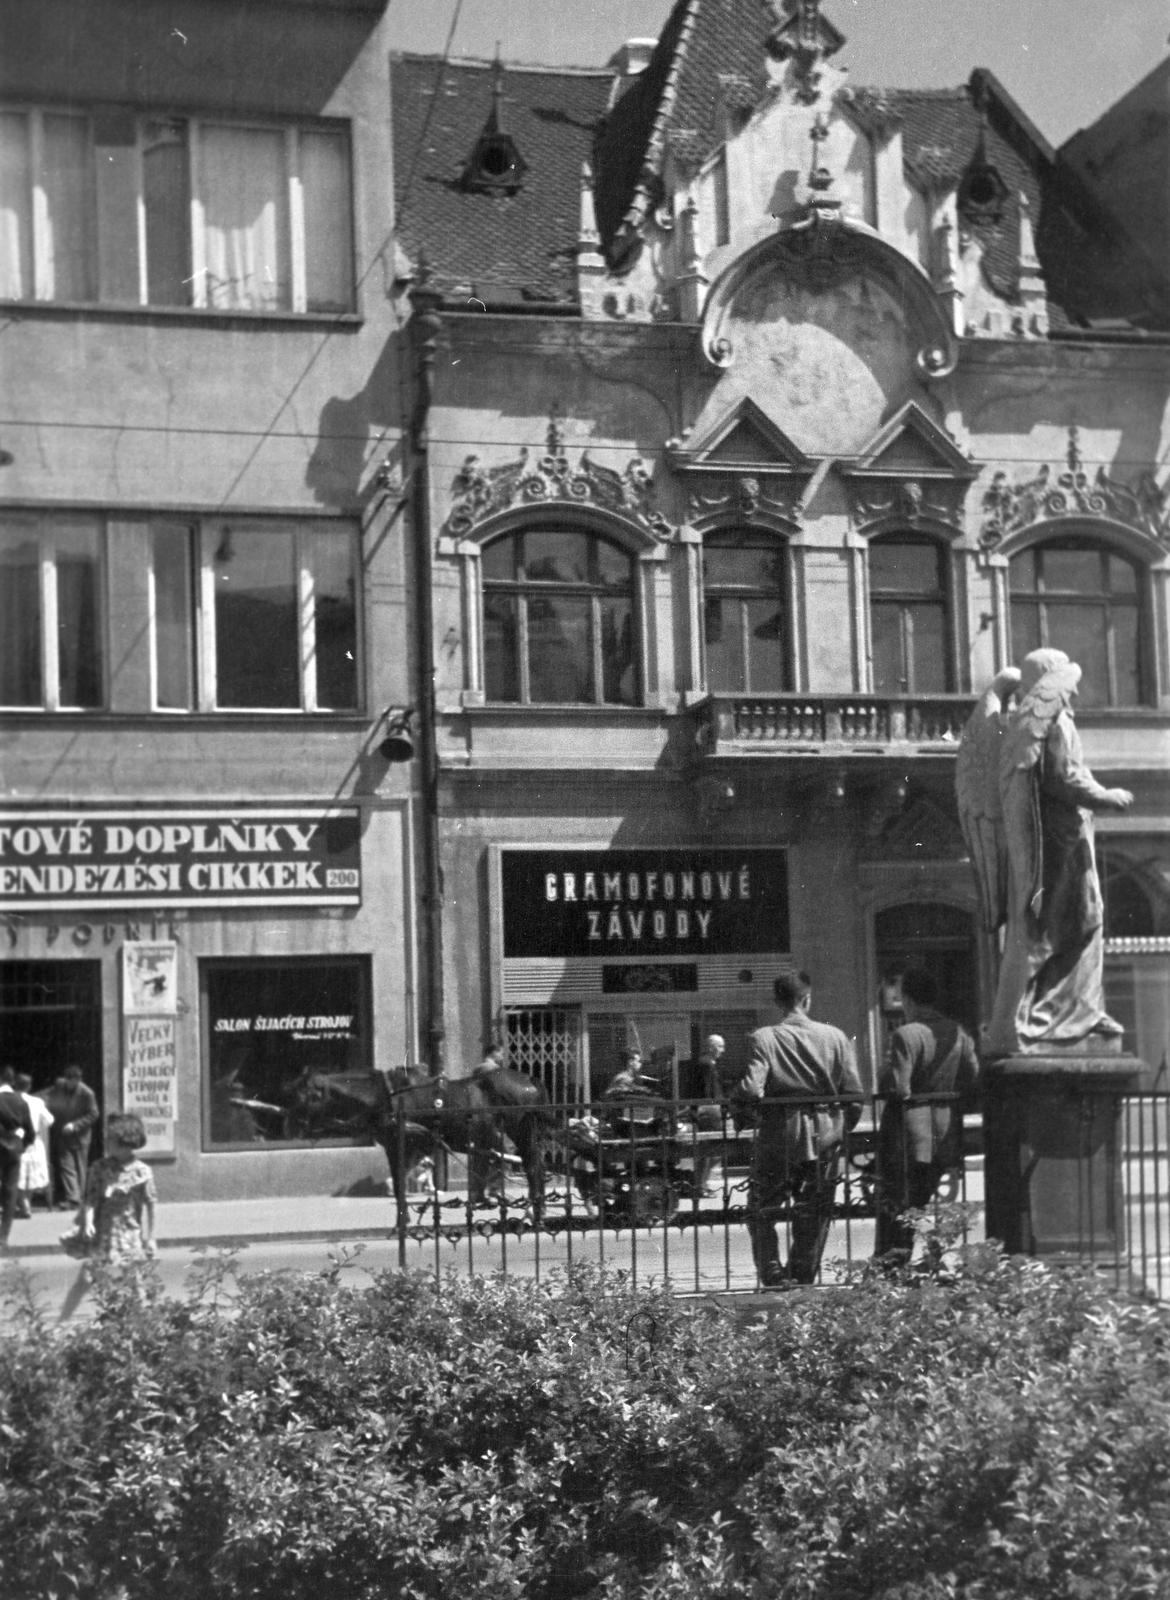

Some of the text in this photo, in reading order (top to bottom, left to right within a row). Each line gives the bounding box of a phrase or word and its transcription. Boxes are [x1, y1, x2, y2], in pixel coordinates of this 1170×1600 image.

[104, 818, 318, 854] DOPLŇKY
[188, 861, 322, 891] CIKKEK
[545, 864, 751, 902] GRAMOFONOVÉ
[587, 905, 712, 940] ZÁVODY
[214, 1018, 250, 1032] SALON
[306, 1014, 354, 1029] STROJOV
